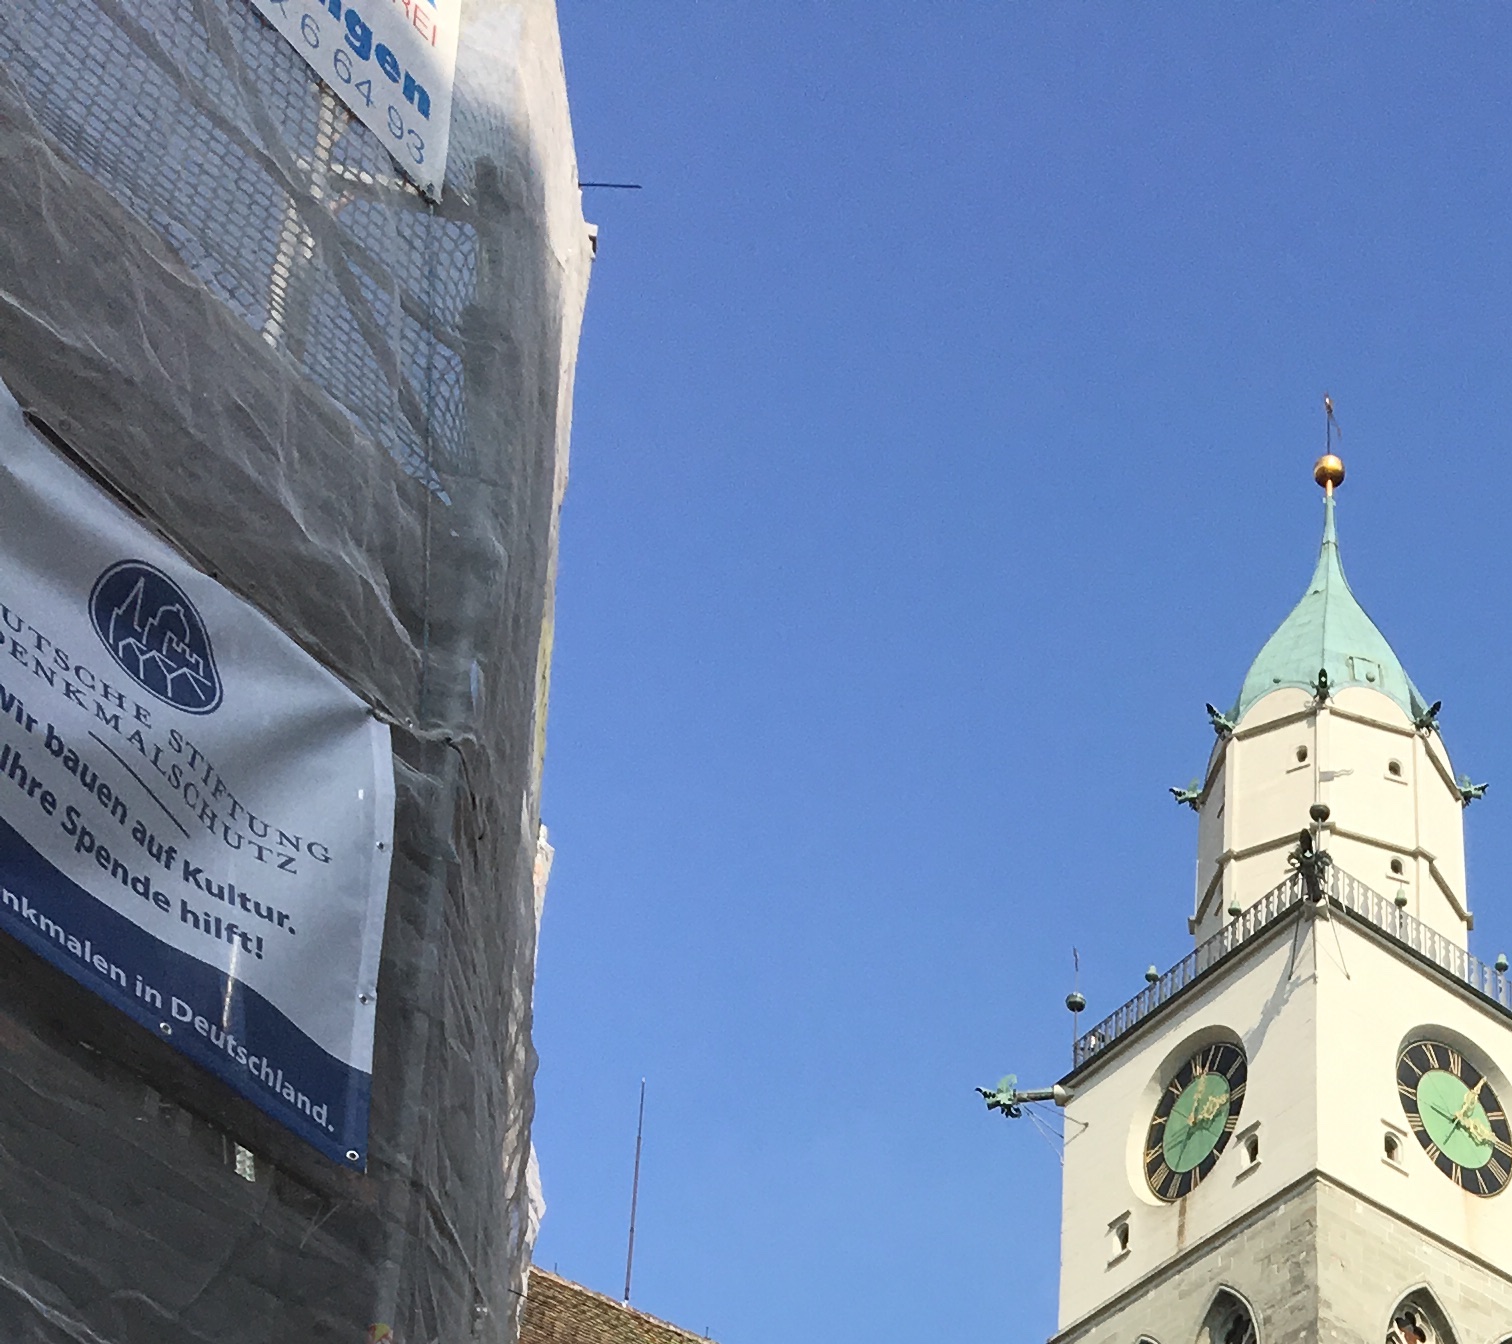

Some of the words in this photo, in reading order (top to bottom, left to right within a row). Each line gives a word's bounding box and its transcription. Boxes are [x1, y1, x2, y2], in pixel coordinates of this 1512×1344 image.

[301, 13, 320, 48] 6
[333, 48, 376, 108] 64
[387, 103, 425, 164] 93
[0, 630, 298, 875] ENKMALSCHUTZ
[44, 722, 128, 826] bauen
[131, 819, 178, 871] auf
[182, 858, 297, 935] Kultur.
[168, 728, 333, 864] STIFTUNG
[0, 743, 57, 816] Ihre
[60, 804, 172, 913] Spende
[180, 898, 264, 960] hilft!
[135, 974, 162, 1009] in
[171, 996, 335, 1132] Deutschland.
